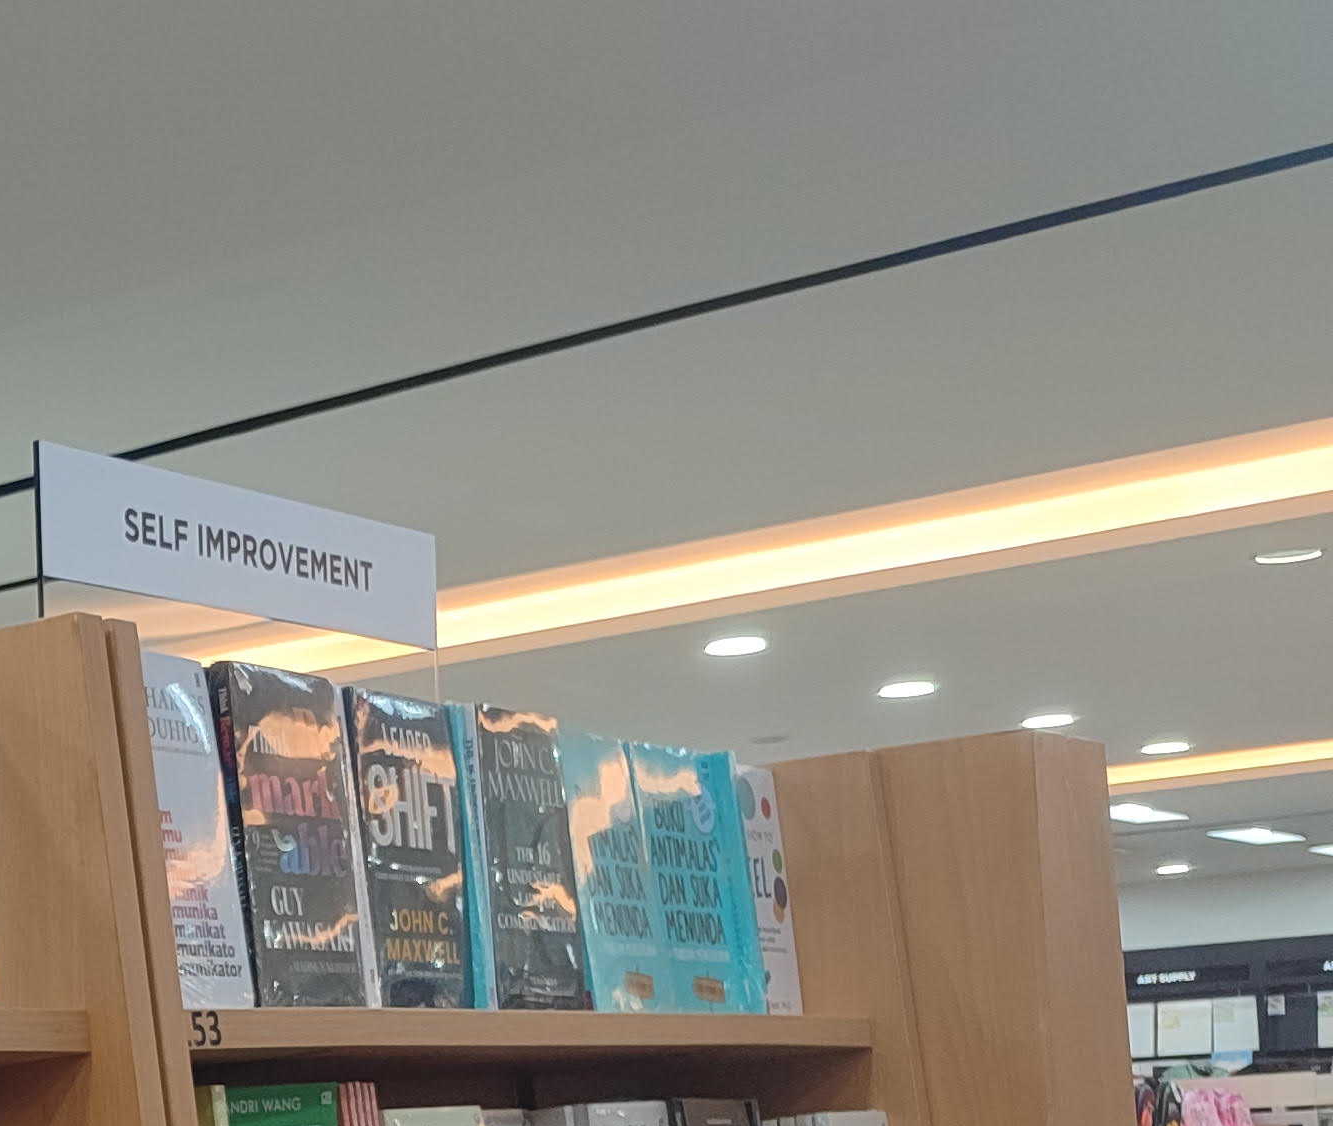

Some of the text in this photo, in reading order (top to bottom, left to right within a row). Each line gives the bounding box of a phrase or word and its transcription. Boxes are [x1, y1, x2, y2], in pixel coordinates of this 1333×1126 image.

[124, 508, 373, 592] SELF IMPROVEMENT
[493, 737, 535, 774] JOHN
[488, 769, 565, 810] MAXWELL
[367, 762, 457, 857] SHIFT
[652, 801, 686, 833] BUKU
[270, 885, 305, 917] GUY
[658, 874, 724, 910] DAN SUKA
[263, 919, 356, 954] KAWASAKI
[389, 908, 454, 937] JOHN C.
[594, 902, 654, 939] MENUNDA
[665, 910, 728, 946] MENUNDA
[386, 938, 461, 966] MAXWELL
[261, 1097, 302, 1114] WANG
